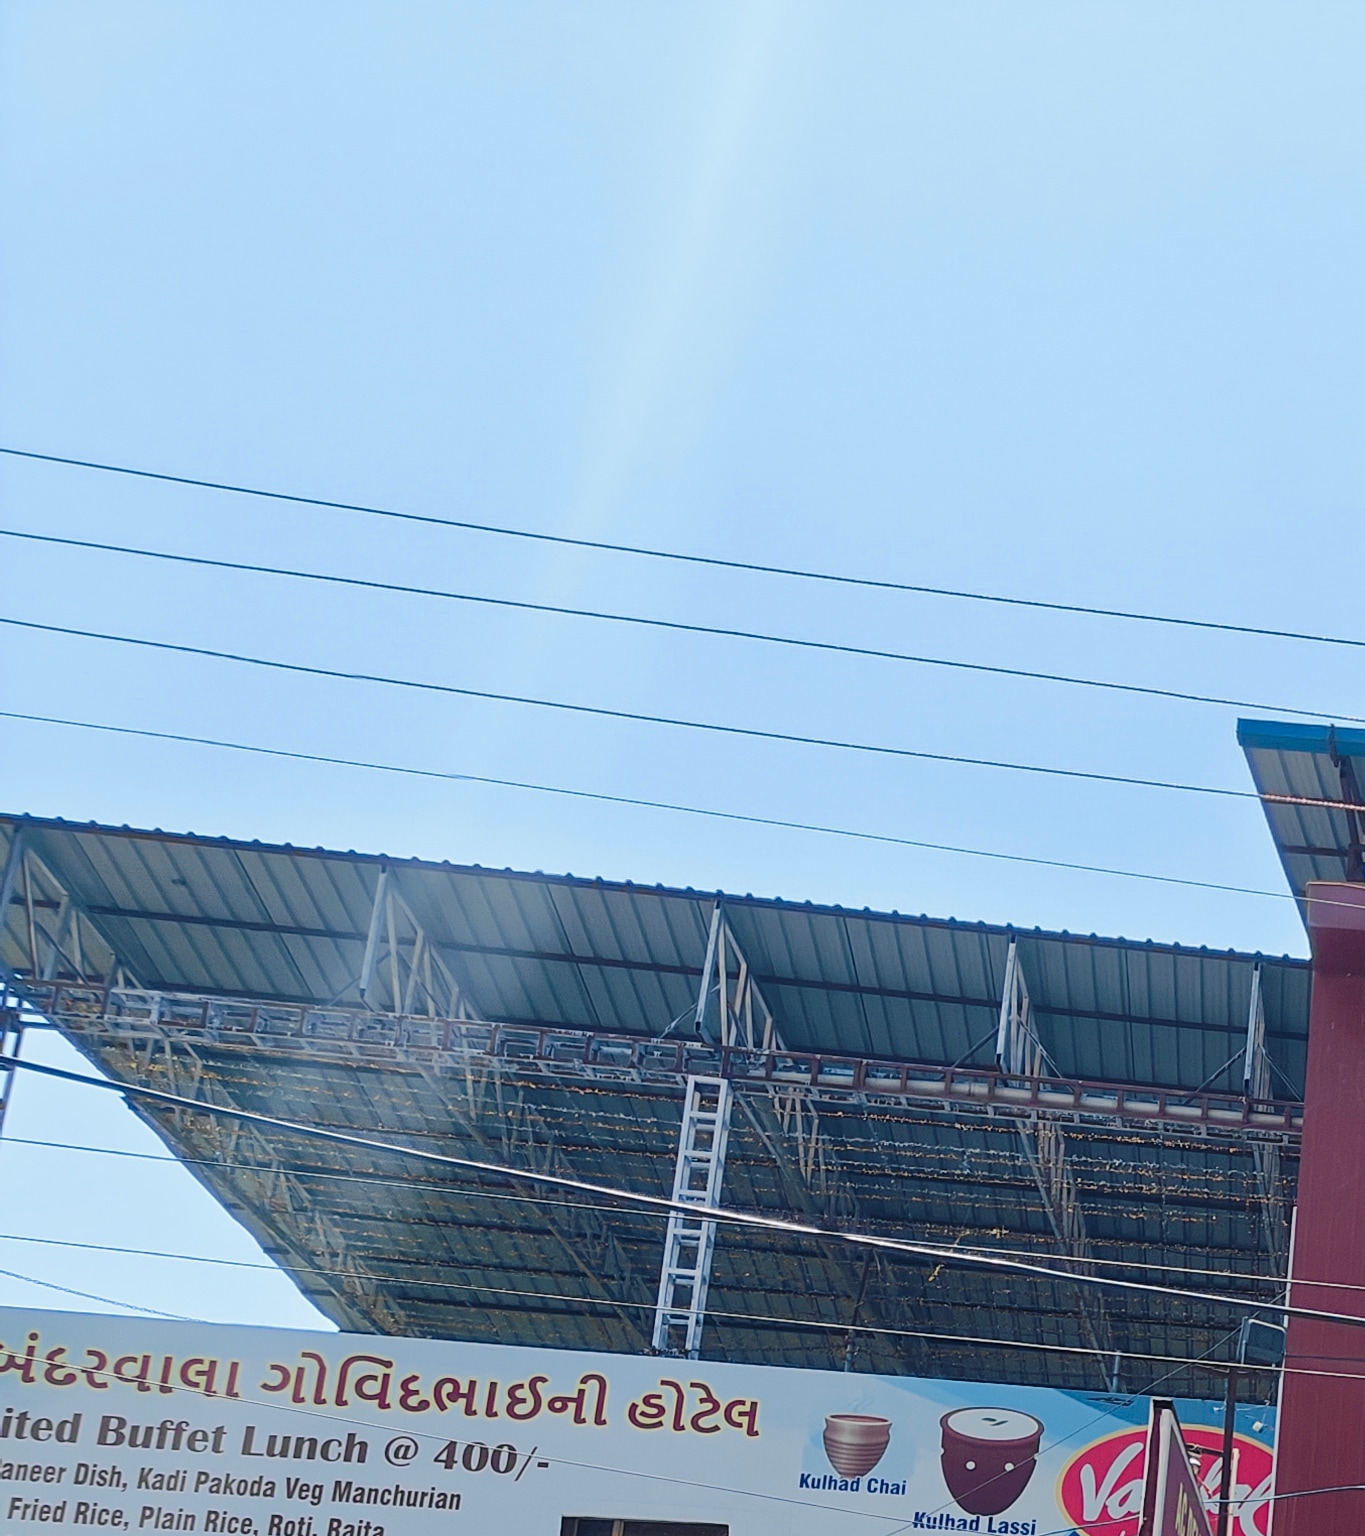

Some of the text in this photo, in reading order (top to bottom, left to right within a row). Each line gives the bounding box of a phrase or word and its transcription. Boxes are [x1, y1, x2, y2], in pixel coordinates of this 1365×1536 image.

[628, 1380, 760, 1437] હોટેલ
[96, 1414, 228, 1454] Buffet
[241, 1426, 368, 1464] Lunch
[383, 1435, 419, 1467] @
[433, 1440, 549, 1482] 400/-
[73, 1462, 128, 1492] Dish,
[137, 1467, 187, 1493] Kadi
[194, 1471, 276, 1498] Pakoda
[286, 1477, 323, 1506] Veg
[331, 1480, 462, 1510] Manchurian
[799, 1473, 907, 1496] Kulhad Chai
[7, 1497, 67, 1524] Fried
[73, 1501, 129, 1531] Rice,
[139, 1505, 195, 1531] Plain
[913, 1512, 1037, 1536] Kulhad Lassi
